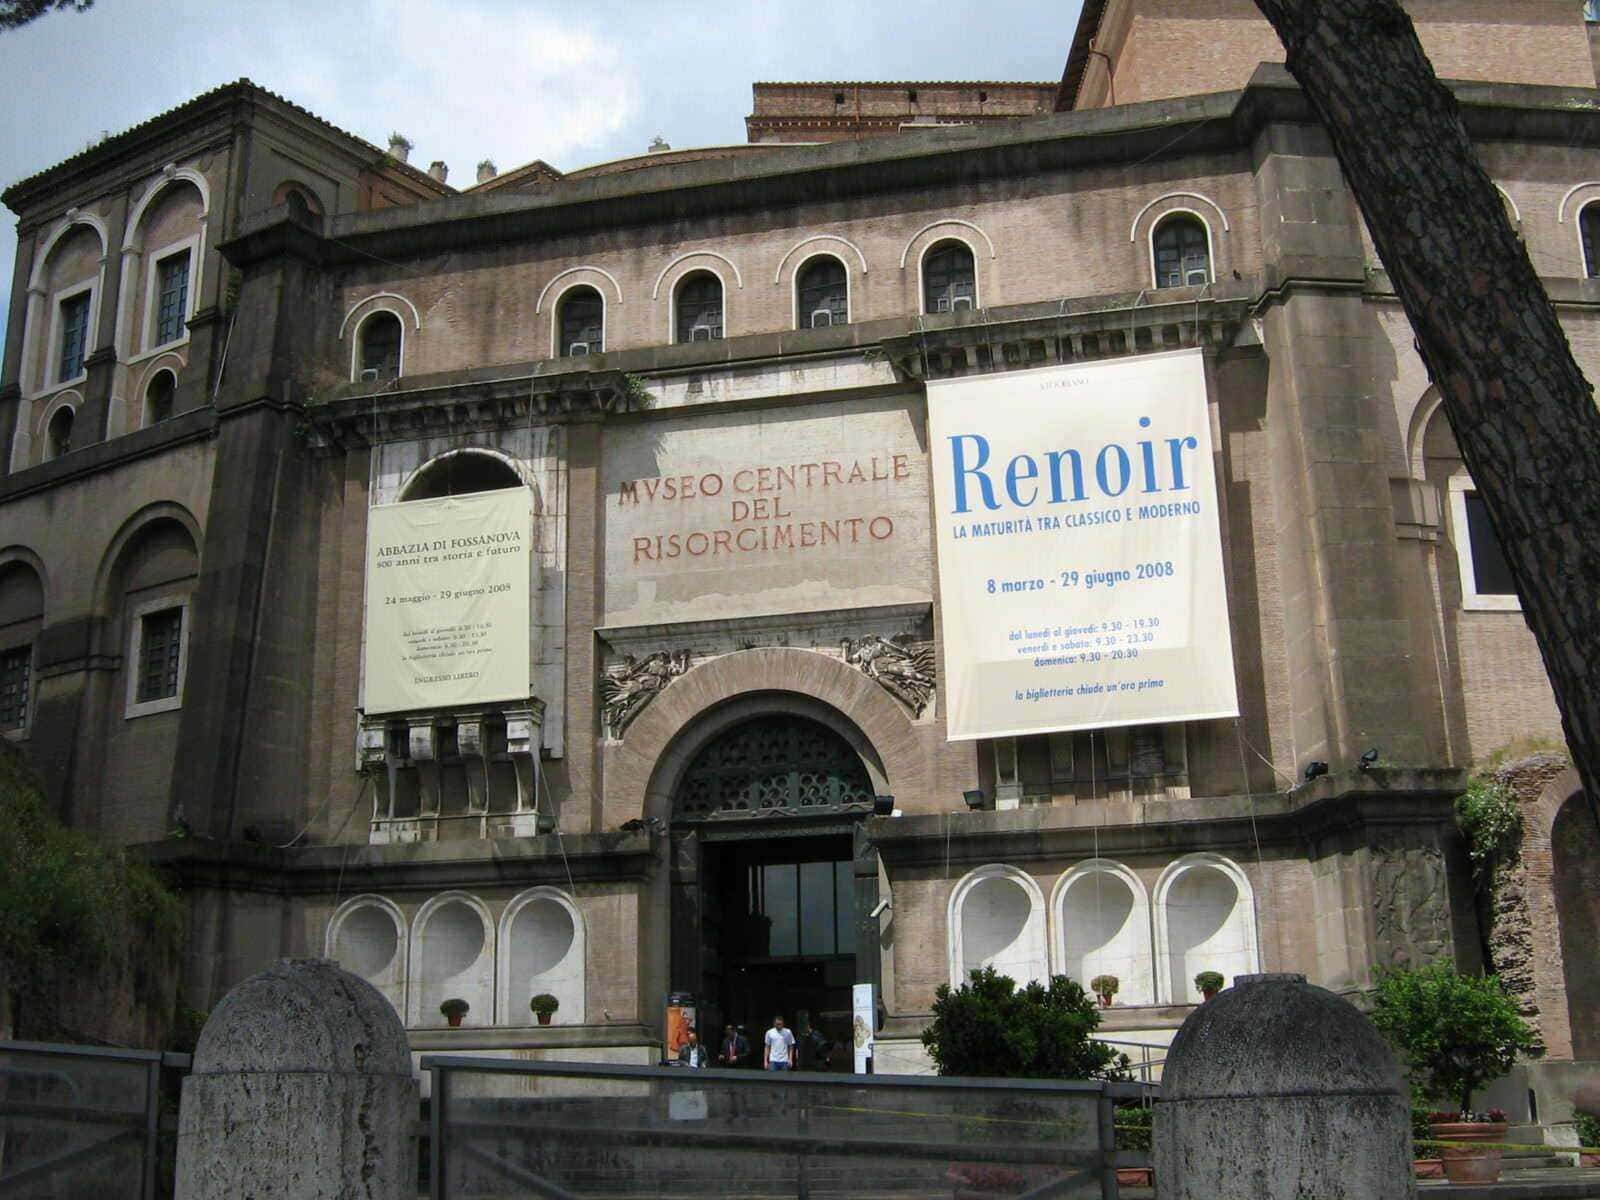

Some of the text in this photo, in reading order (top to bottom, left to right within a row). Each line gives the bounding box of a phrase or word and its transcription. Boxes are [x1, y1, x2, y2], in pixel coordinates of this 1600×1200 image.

[946, 416, 1198, 515] Renoir
[618, 454, 911, 505] MVSEO CENTRALE
[731, 497, 791, 522] DEL
[953, 501, 1201, 539] LA MATURITÀ TRA CLASSICO E MODERNO
[376, 531, 521, 557] ABBAZIA DI FOSSANOVA
[632, 516, 894, 562] RISORCIMENTO
[395, 555, 420, 567] anni
[423, 554, 439, 564] tra
[443, 549, 473, 561] storia
[486, 545, 521, 556] futuro
[986, 579, 996, 594] 8
[1001, 578, 1044, 593] marzo
[1061, 571, 1079, 587] 29
[1085, 569, 1131, 588] giugno
[1136, 561, 1174, 579] 2008
[440, 590, 452, 600] 29
[454, 588, 485, 600] giugno
[488, 583, 511, 594] 2008
[1009, 630, 1022, 641] dal
[1053, 627, 1062, 636] al
[1102, 621, 1122, 632] 9.30
[1134, 617, 1160, 629] 19.30
[1096, 636, 1116, 647] 9.30
[1127, 632, 1154, 644] 23.30
[1080, 651, 1101, 663] 9.30
[1015, 690, 1024, 700] la
[1026, 686, 1074, 702] biglietteria
[1076, 682, 1104, 696] chiude
[1138, 678, 1164, 692] prima
